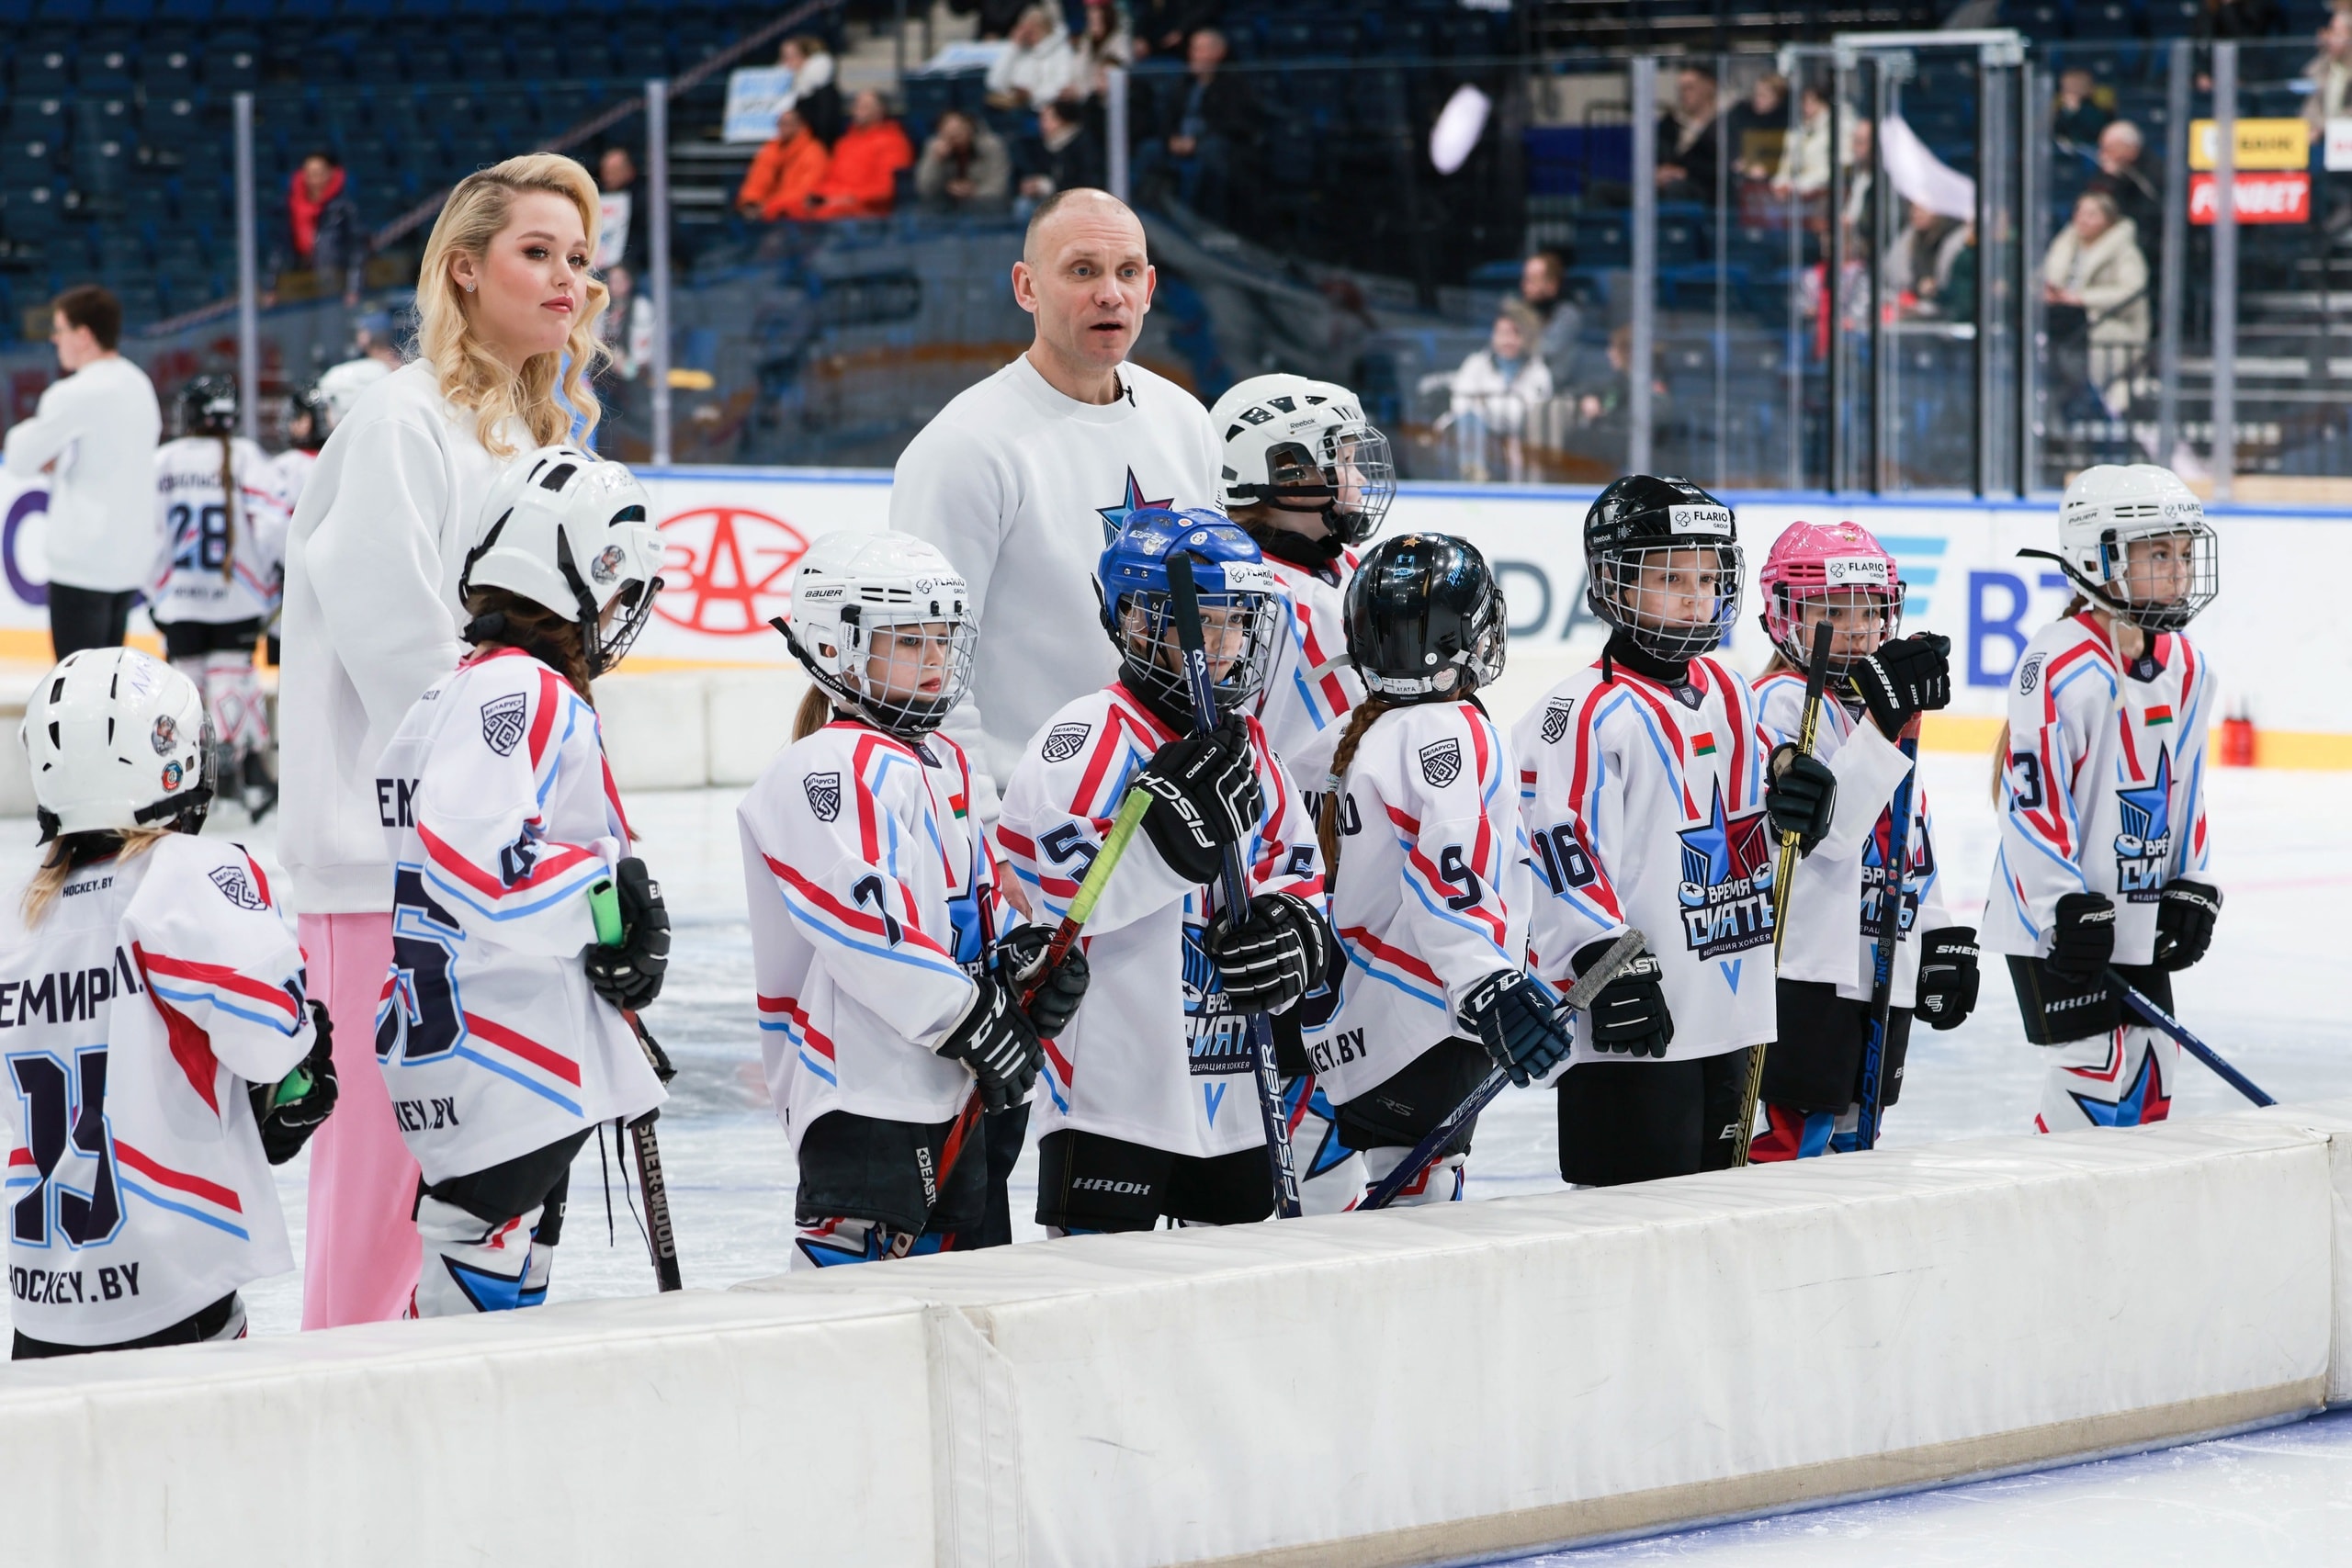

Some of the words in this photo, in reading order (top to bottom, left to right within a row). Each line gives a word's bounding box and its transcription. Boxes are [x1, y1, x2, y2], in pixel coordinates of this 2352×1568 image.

[2190, 180, 2307, 215] FNBET
[1289, 417, 1317, 430] Reebok
[1693, 510, 1728, 523] FLARIO
[1593, 534, 1612, 544] Reebok
[1848, 561, 1885, 573] FLARIO
[1053, 725, 1087, 735] БЕЛАРУСЬ
[1421, 742, 1456, 759] БЕЛАРУСЬ
[2009, 749, 2046, 813] 3
[1036, 819, 1102, 887] 5
[1532, 821, 1598, 898] 16
[62, 874, 115, 899] HOCKEY.BY
[1702, 942, 1738, 957] ФЕДЕРАЦИЯ
[1738, 932, 1772, 949] ХОККЕЯ
[1189, 1063, 1226, 1073] ЕДЕРАЦИЯ
[1227, 1060, 1250, 1071] ХОККЕЯ
[1261, 1043, 1300, 1203] FISCHER
